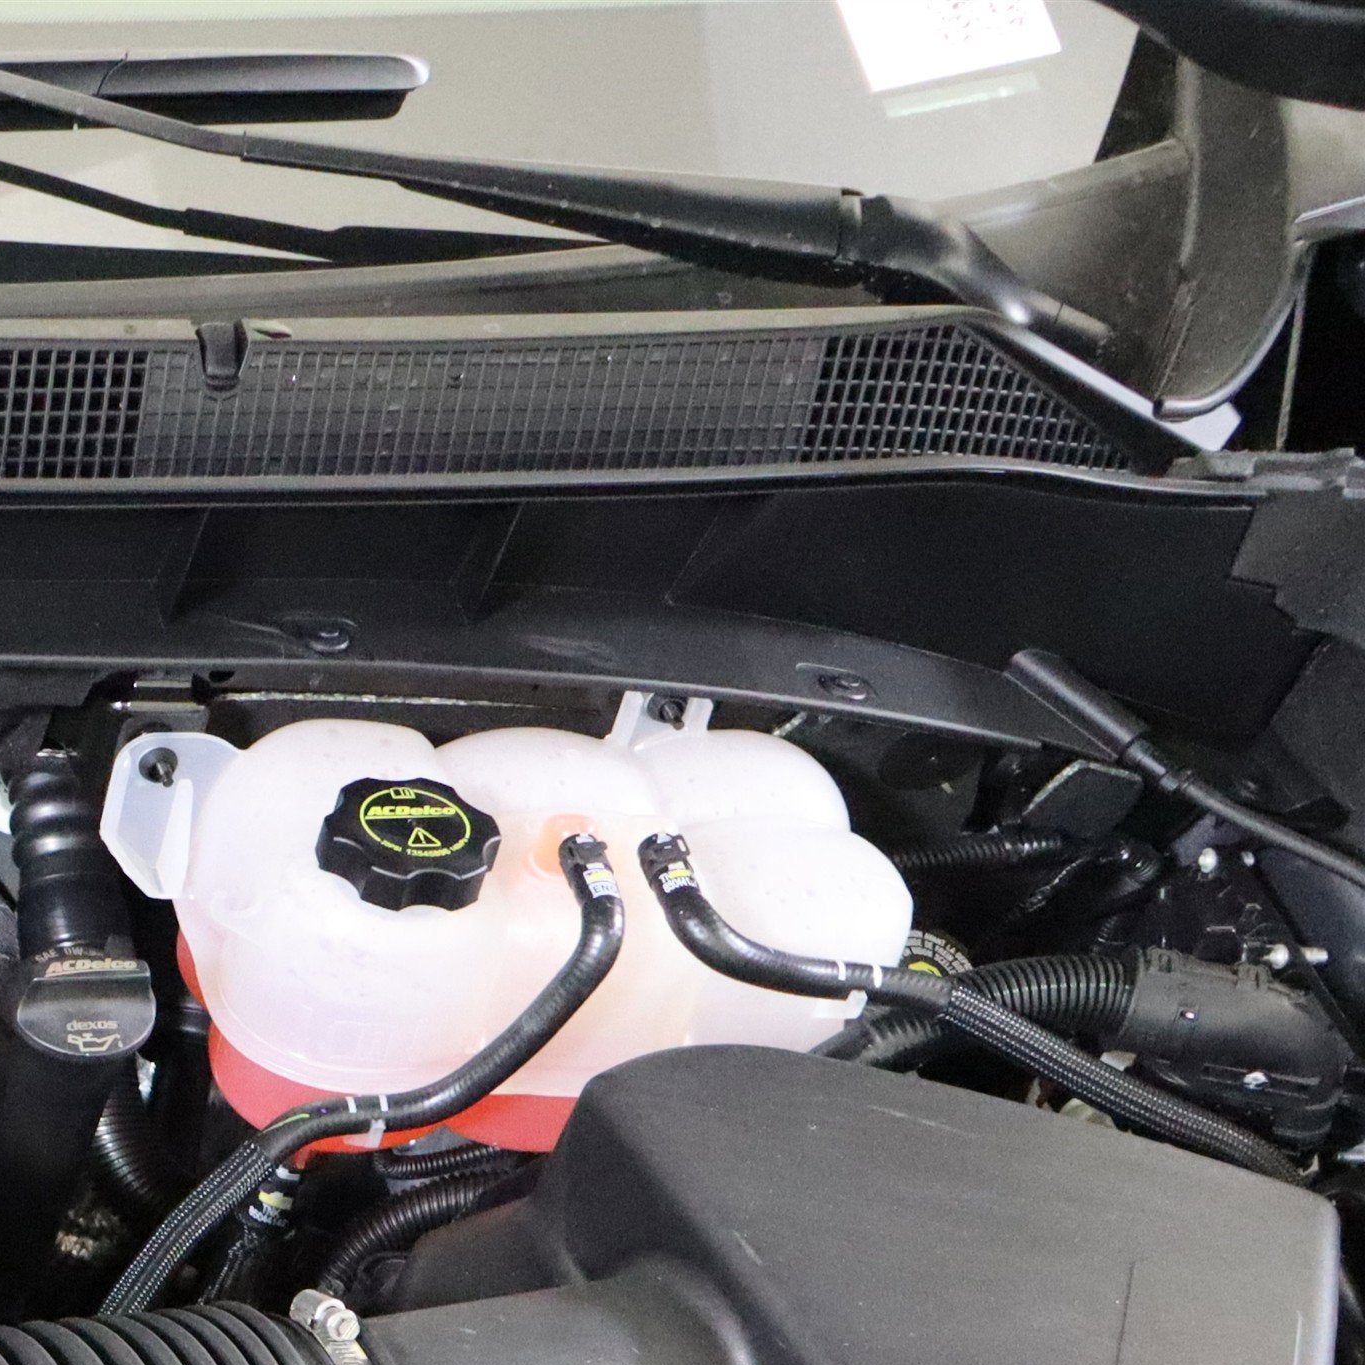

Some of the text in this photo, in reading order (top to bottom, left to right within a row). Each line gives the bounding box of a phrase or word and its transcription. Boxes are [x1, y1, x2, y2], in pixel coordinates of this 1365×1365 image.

[367, 804, 456, 816] ACDelco
[45, 958, 138, 974] ACDelco
[66, 1020, 118, 1031] dexos
